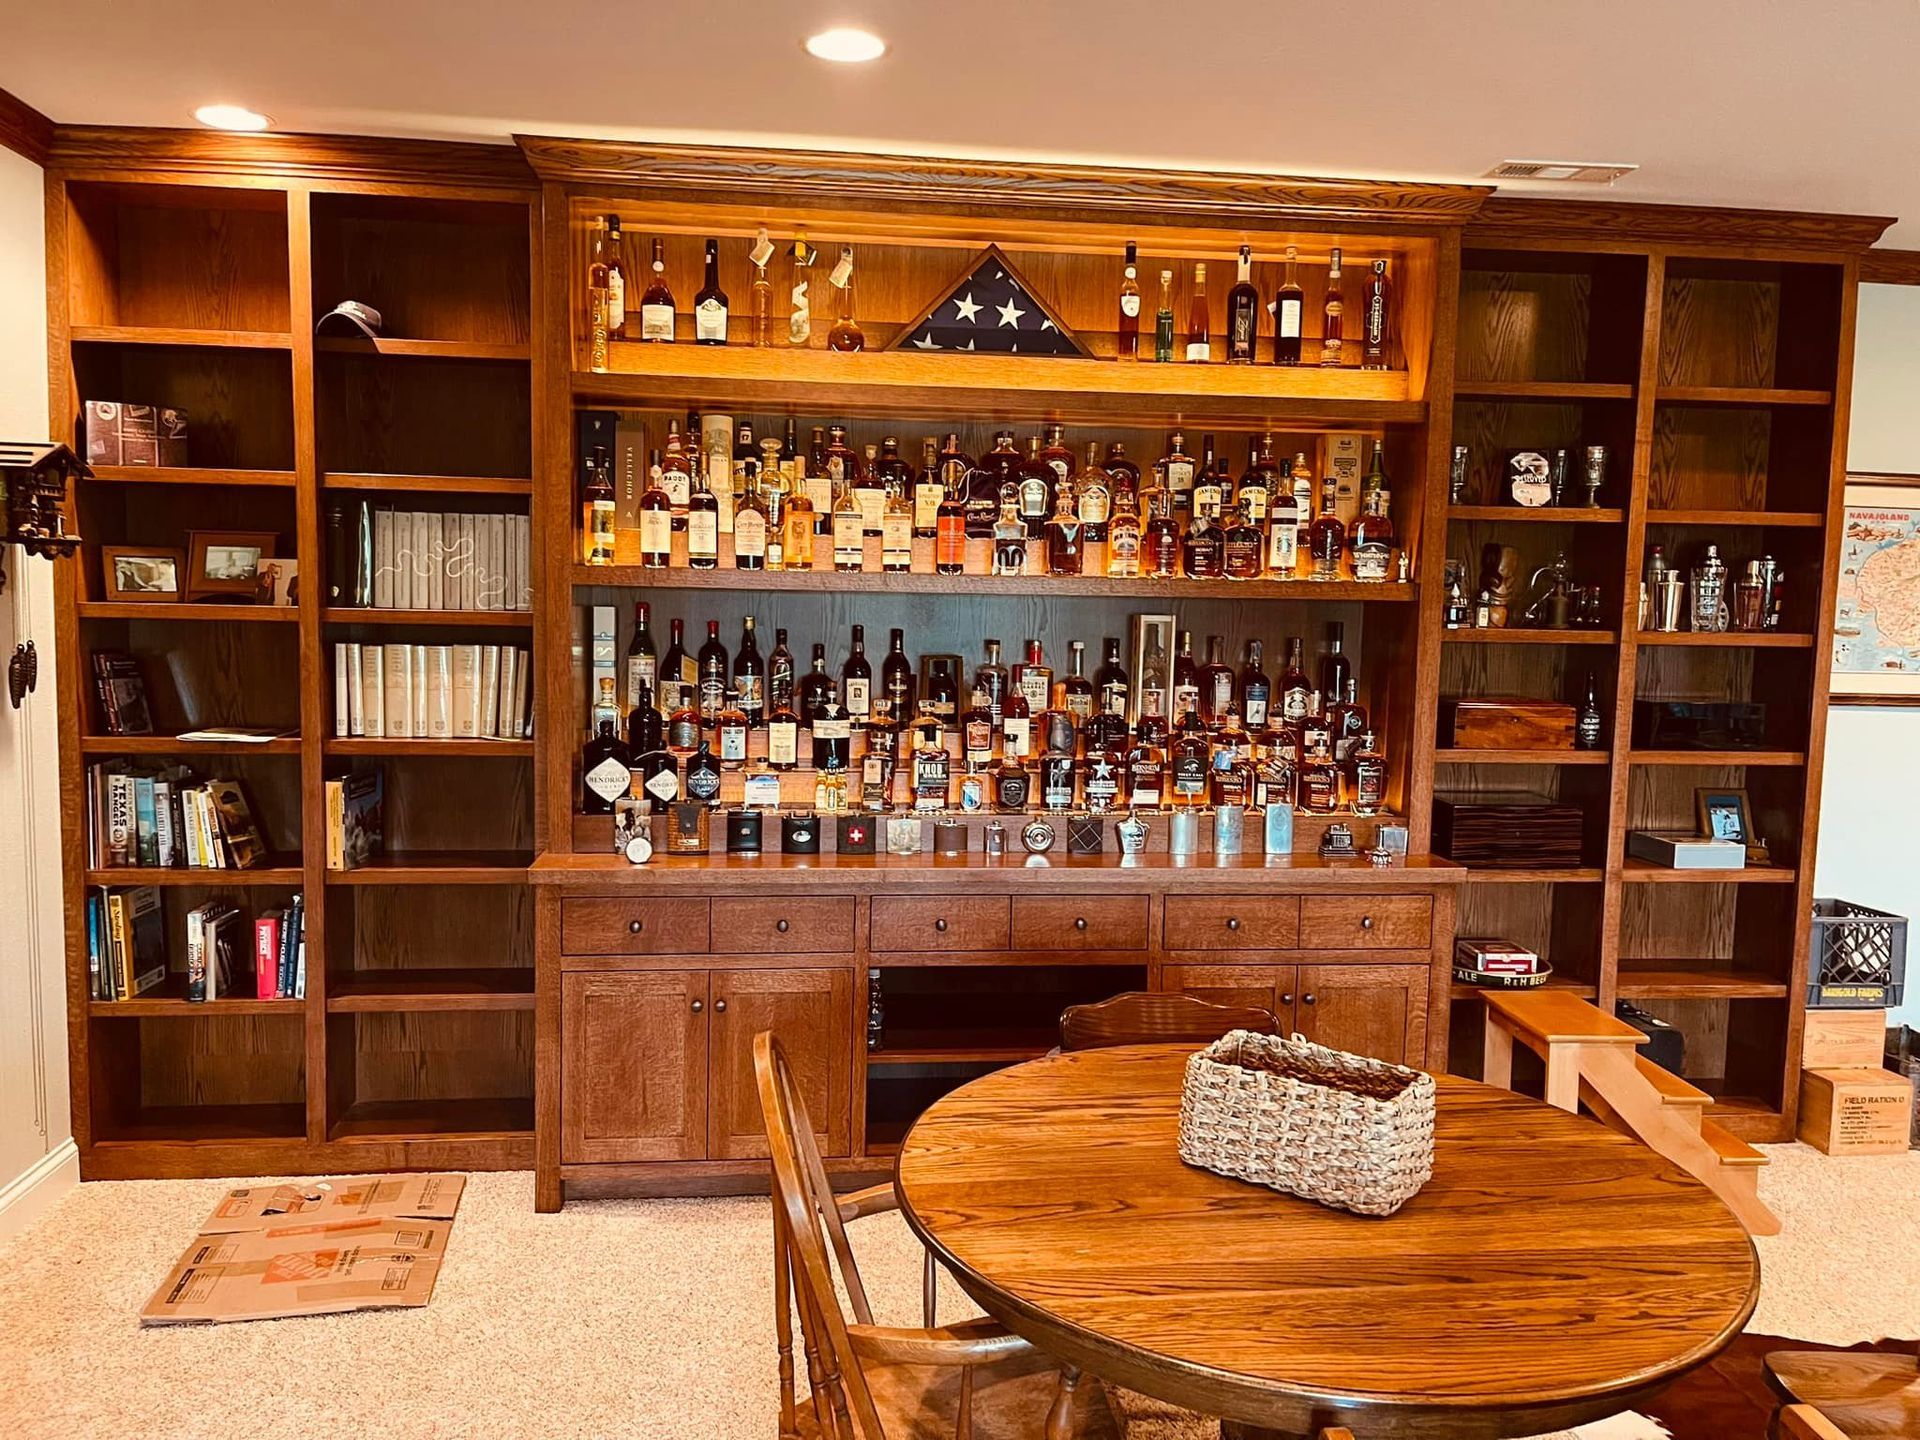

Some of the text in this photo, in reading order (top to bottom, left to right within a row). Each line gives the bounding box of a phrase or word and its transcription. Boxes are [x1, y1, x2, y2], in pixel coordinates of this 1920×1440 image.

[1849, 512, 1910, 521] NAVAJOLAND
[919, 763, 943, 774] KNOB
[119, 783, 127, 826] TEXAS
[1457, 970, 1477, 982] ALE
[1822, 987, 1884, 998] MARIGOLD FARMS
[1844, 1097, 1867, 1105] FIELD
[1868, 1096, 1898, 1104] RATION
